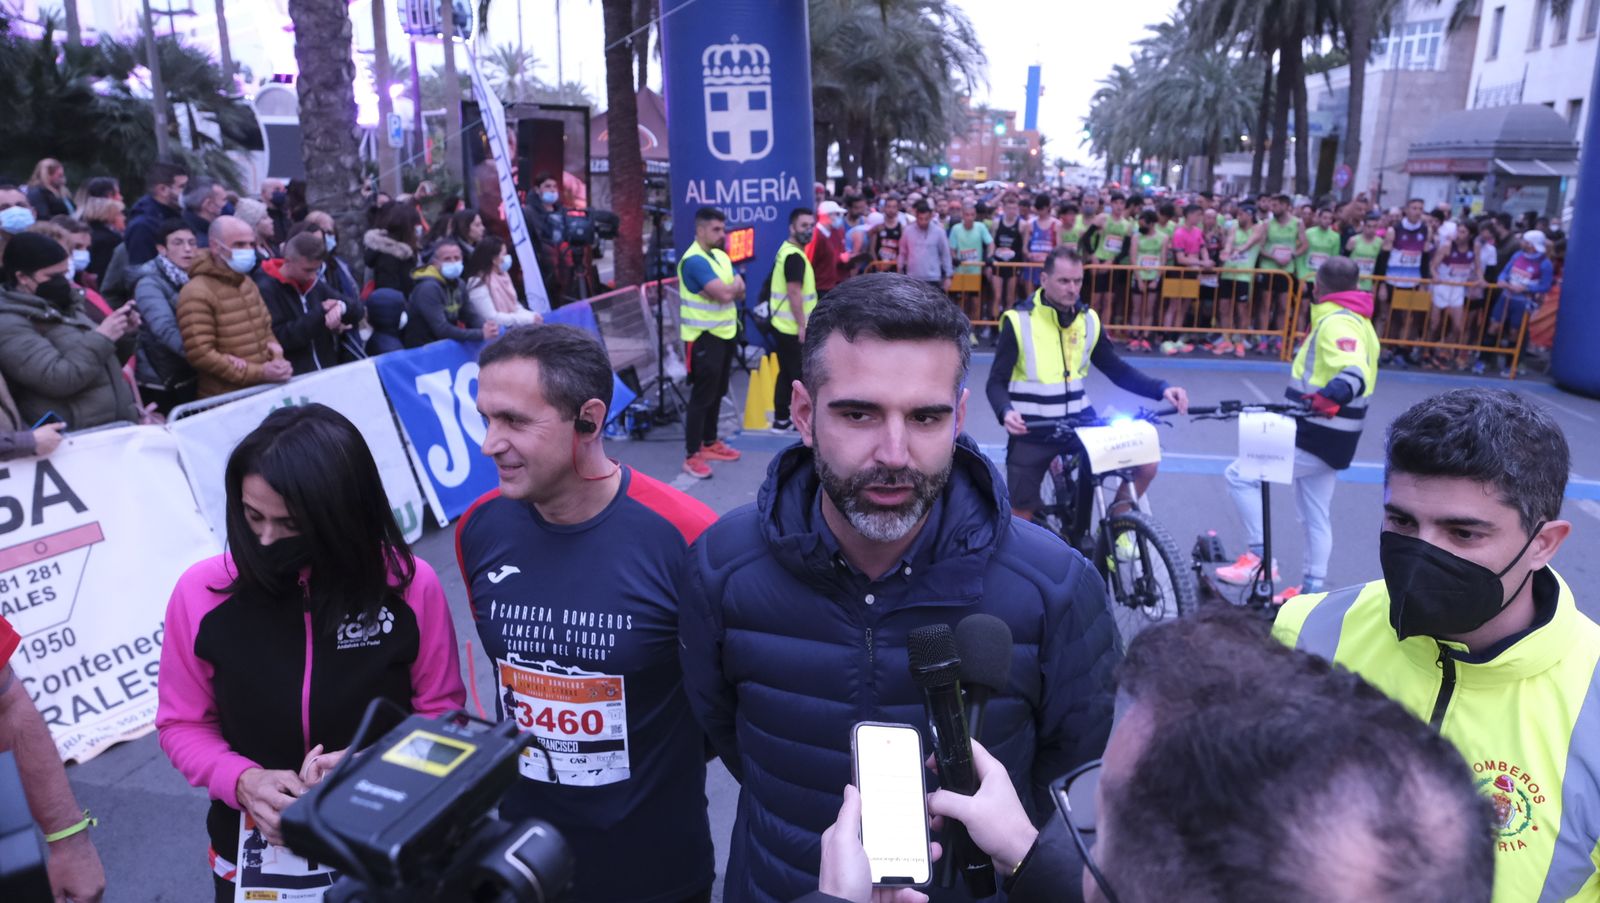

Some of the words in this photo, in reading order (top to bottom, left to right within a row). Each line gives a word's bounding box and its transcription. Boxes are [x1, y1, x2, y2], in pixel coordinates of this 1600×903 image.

[685, 171, 801, 204] ALMERÍA
[26, 561, 62, 584] 281
[1, 585, 57, 617] ALES
[500, 603, 552, 622] CARRERA
[563, 609, 632, 630] BOMBEROS
[19, 627, 76, 664] 1950
[502, 623, 554, 640] ALMERÍA
[566, 629, 615, 647] CIUDAD
[553, 644, 569, 656] DEL
[517, 701, 604, 736] 3460
[1473, 760, 1546, 804] OMBEROS
